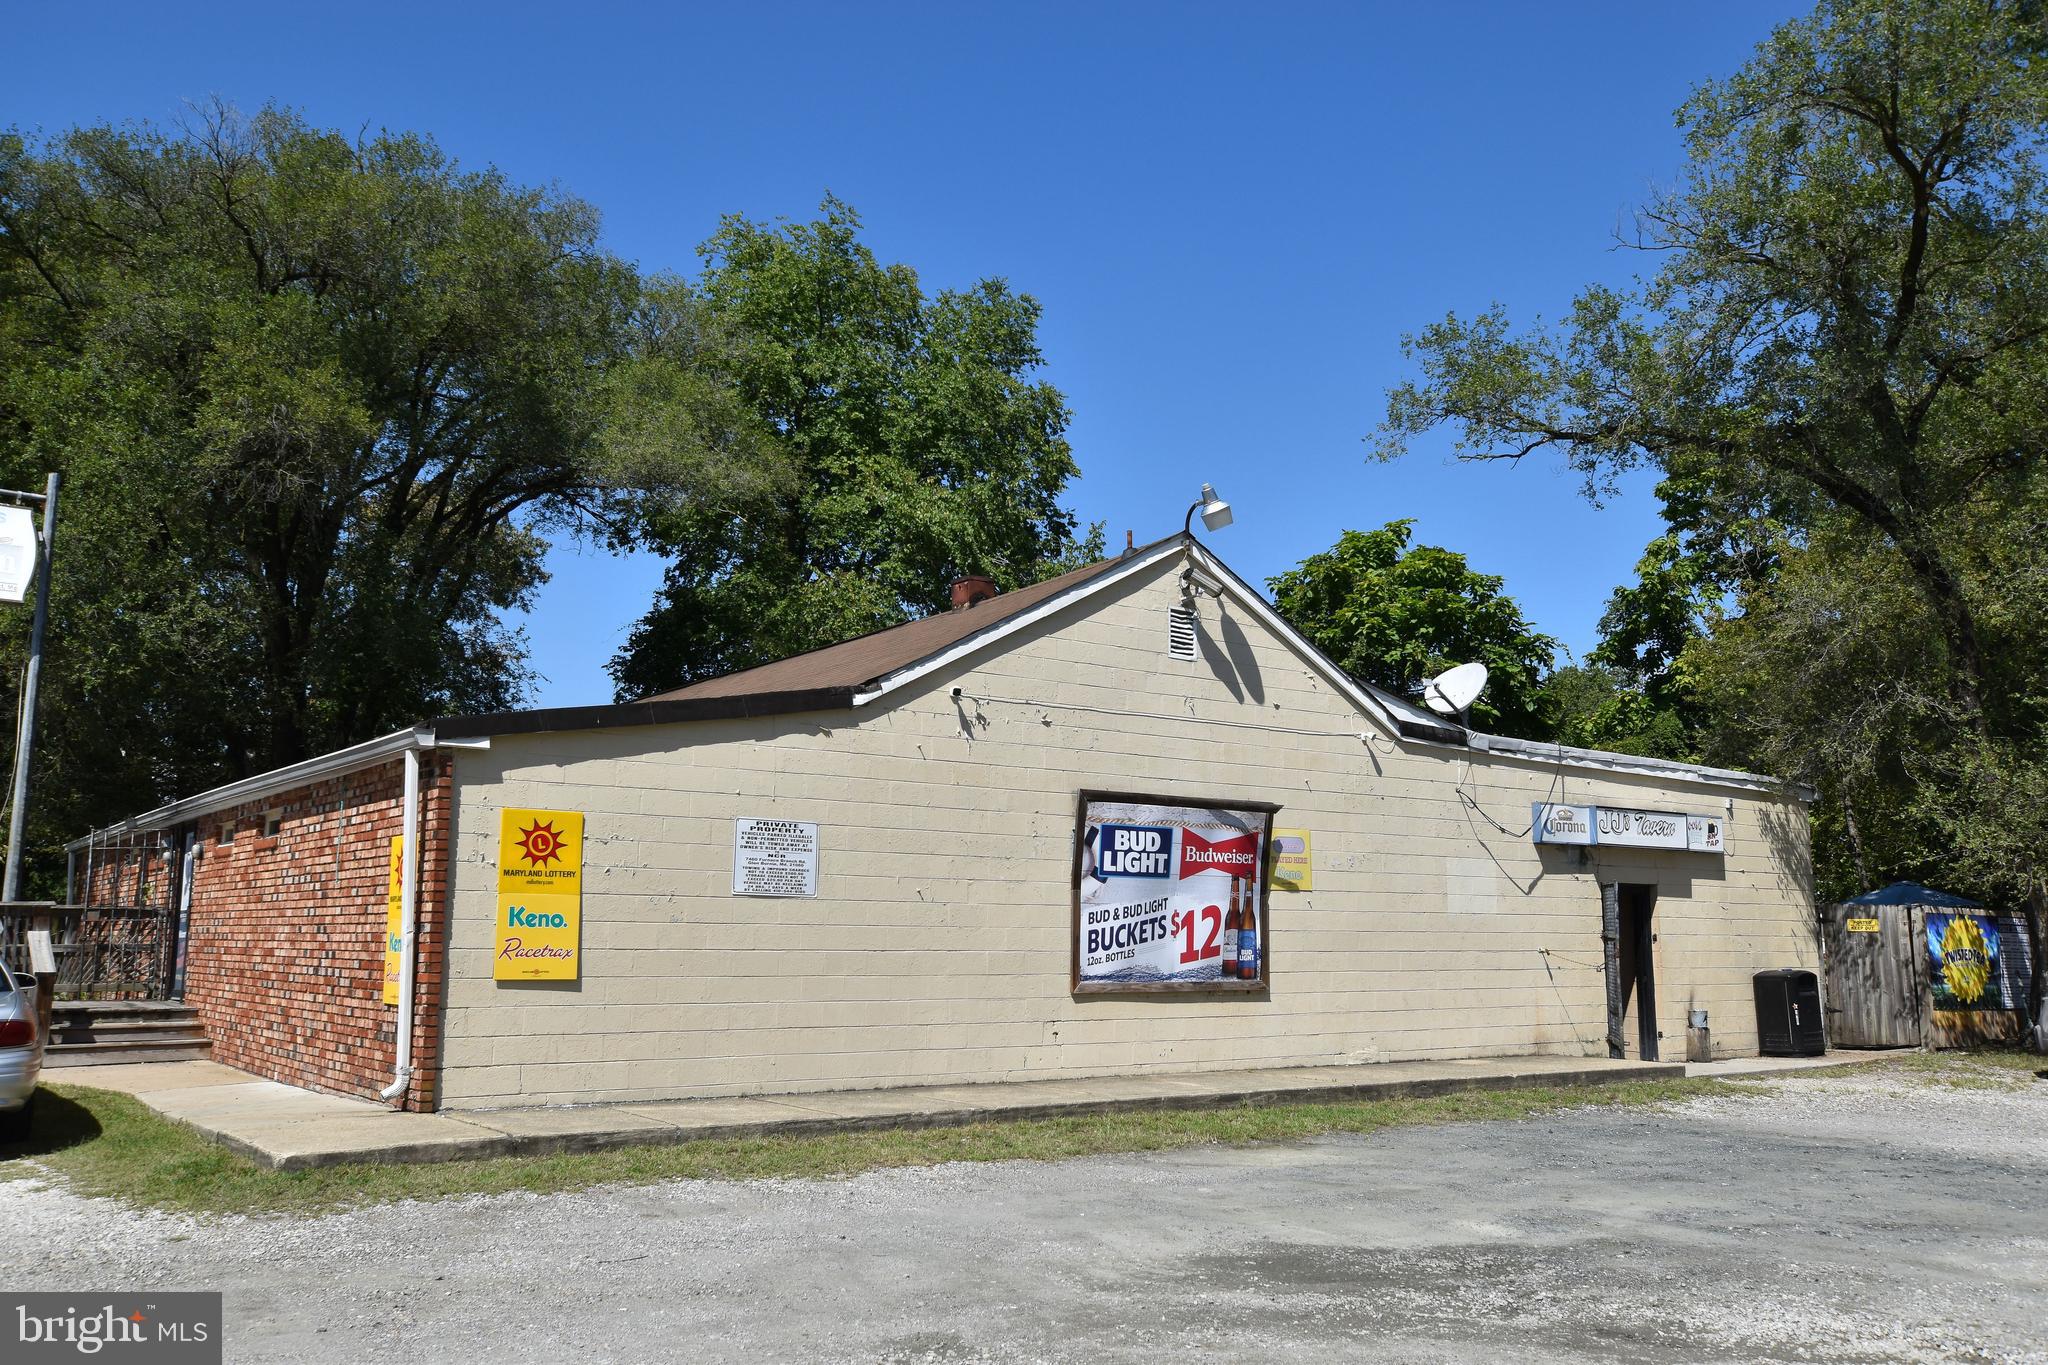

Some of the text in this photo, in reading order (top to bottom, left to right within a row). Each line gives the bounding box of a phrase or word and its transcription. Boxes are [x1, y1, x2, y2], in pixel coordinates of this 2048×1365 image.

[1544, 818, 1586, 836] Corona
[1599, 809, 1676, 836] JJ's Tavern
[1114, 830, 1161, 852] BUD
[1103, 851, 1168, 874] LIGHT
[1185, 846, 1254, 865] Budweiser
[1088, 897, 1168, 925] BUD & BUD LIGHT
[390, 931, 402, 952] Ken
[1088, 914, 1167, 954] BUCKETS
[1170, 904, 1222, 964] $12
[498, 938, 574, 960] Racetrax
[1087, 948, 1135, 966] 12oz. BOTTLES
[1945, 948, 1972, 964] TWISTED
